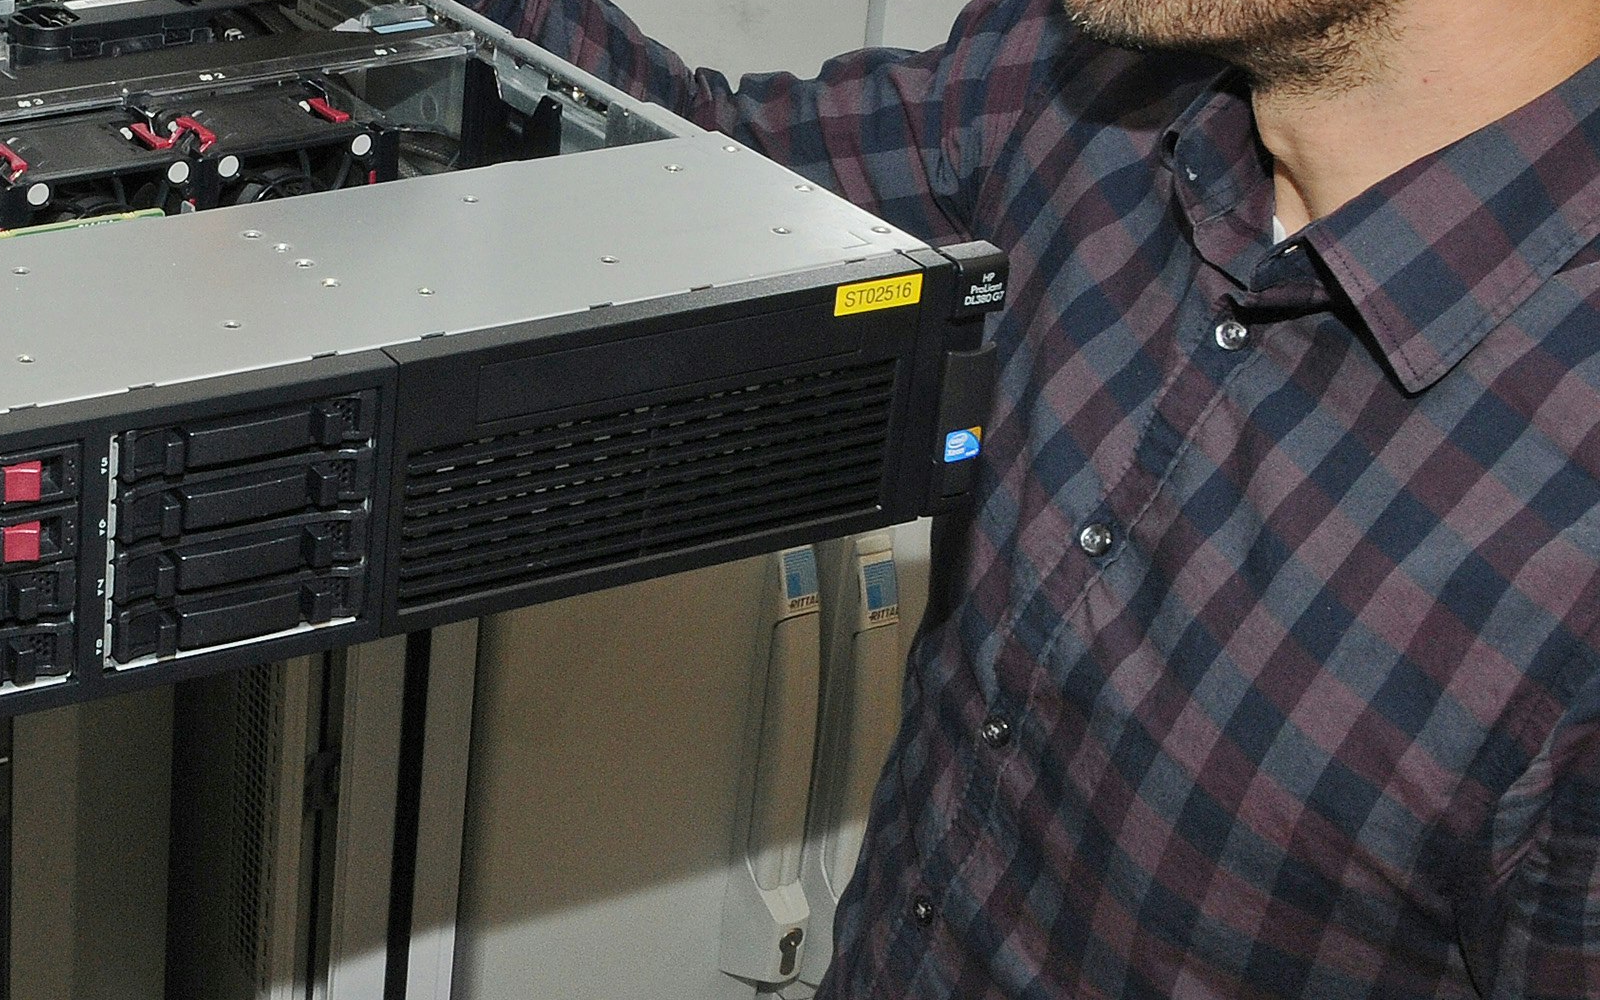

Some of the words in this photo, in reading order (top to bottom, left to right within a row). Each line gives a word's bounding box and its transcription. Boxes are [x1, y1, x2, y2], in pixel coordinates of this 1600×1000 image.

[982, 272, 996, 283] HP
[844, 282, 912, 308] ST02516
[101, 457, 108, 467] 5
[98, 518, 106, 528] 6
[97, 579, 105, 589] 7
[95, 638, 103, 648] 8
